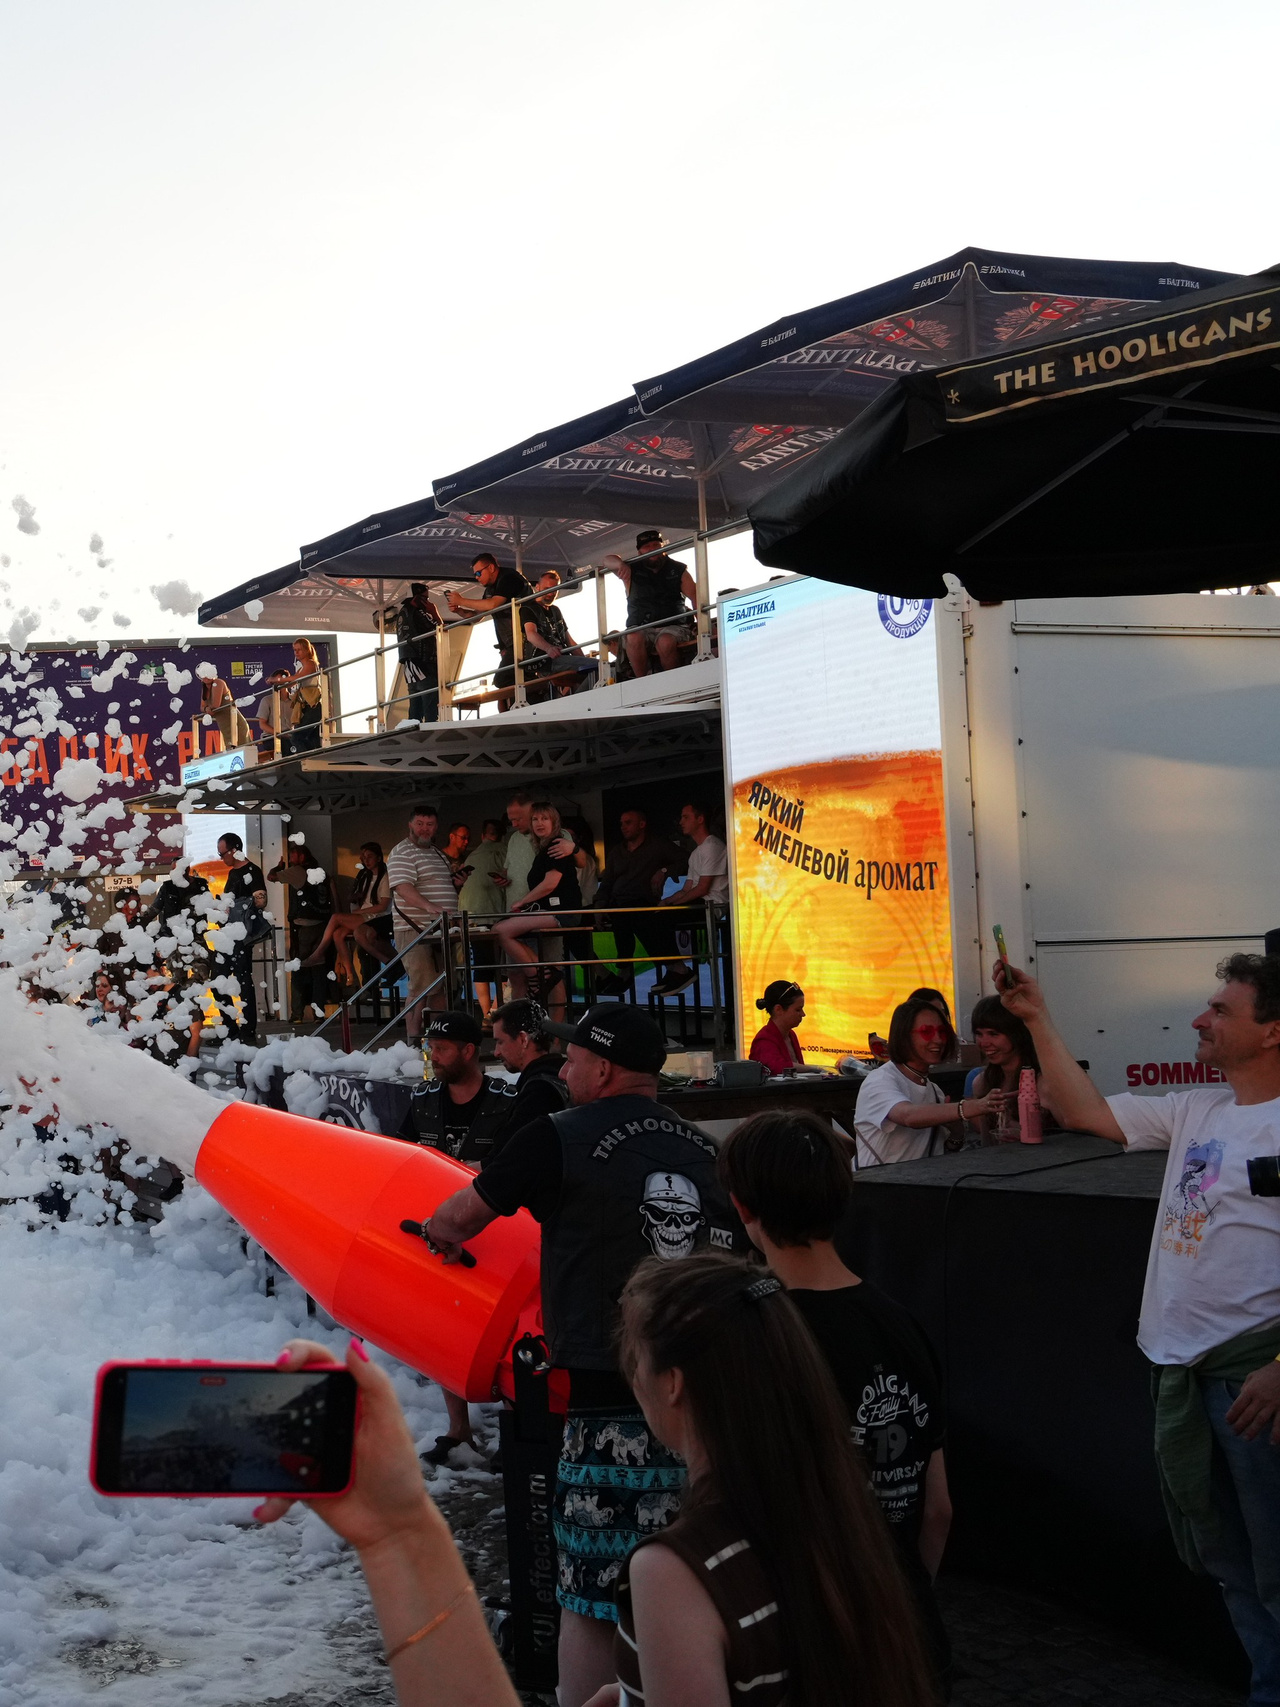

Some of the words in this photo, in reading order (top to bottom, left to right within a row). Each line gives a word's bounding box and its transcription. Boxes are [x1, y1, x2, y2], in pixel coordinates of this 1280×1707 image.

[920, 268, 962, 289] БАЛТИКА
[989, 264, 1026, 278] БАЛТИКА
[1166, 277, 1200, 290] БАЛТИКА
[767, 326, 797, 347] БАЛТИКА
[994, 361, 1056, 394] THE
[1073, 307, 1272, 377] HOOLIGANS
[735, 600, 775, 622] БАЛТИКА
[884, 608, 929, 639] ПРОДУКЦИЯ
[747, 780, 805, 834] ЯРКИЙ
[753, 817, 850, 885] ХМЕЛЕВОЙ
[854, 858, 939, 901] аромат
[589, 1031, 613, 1047] THMC
[591, 1025, 616, 1039] SUPPORT
[592, 1128, 627, 1159] THE
[710, 1229, 733, 1247] MC
